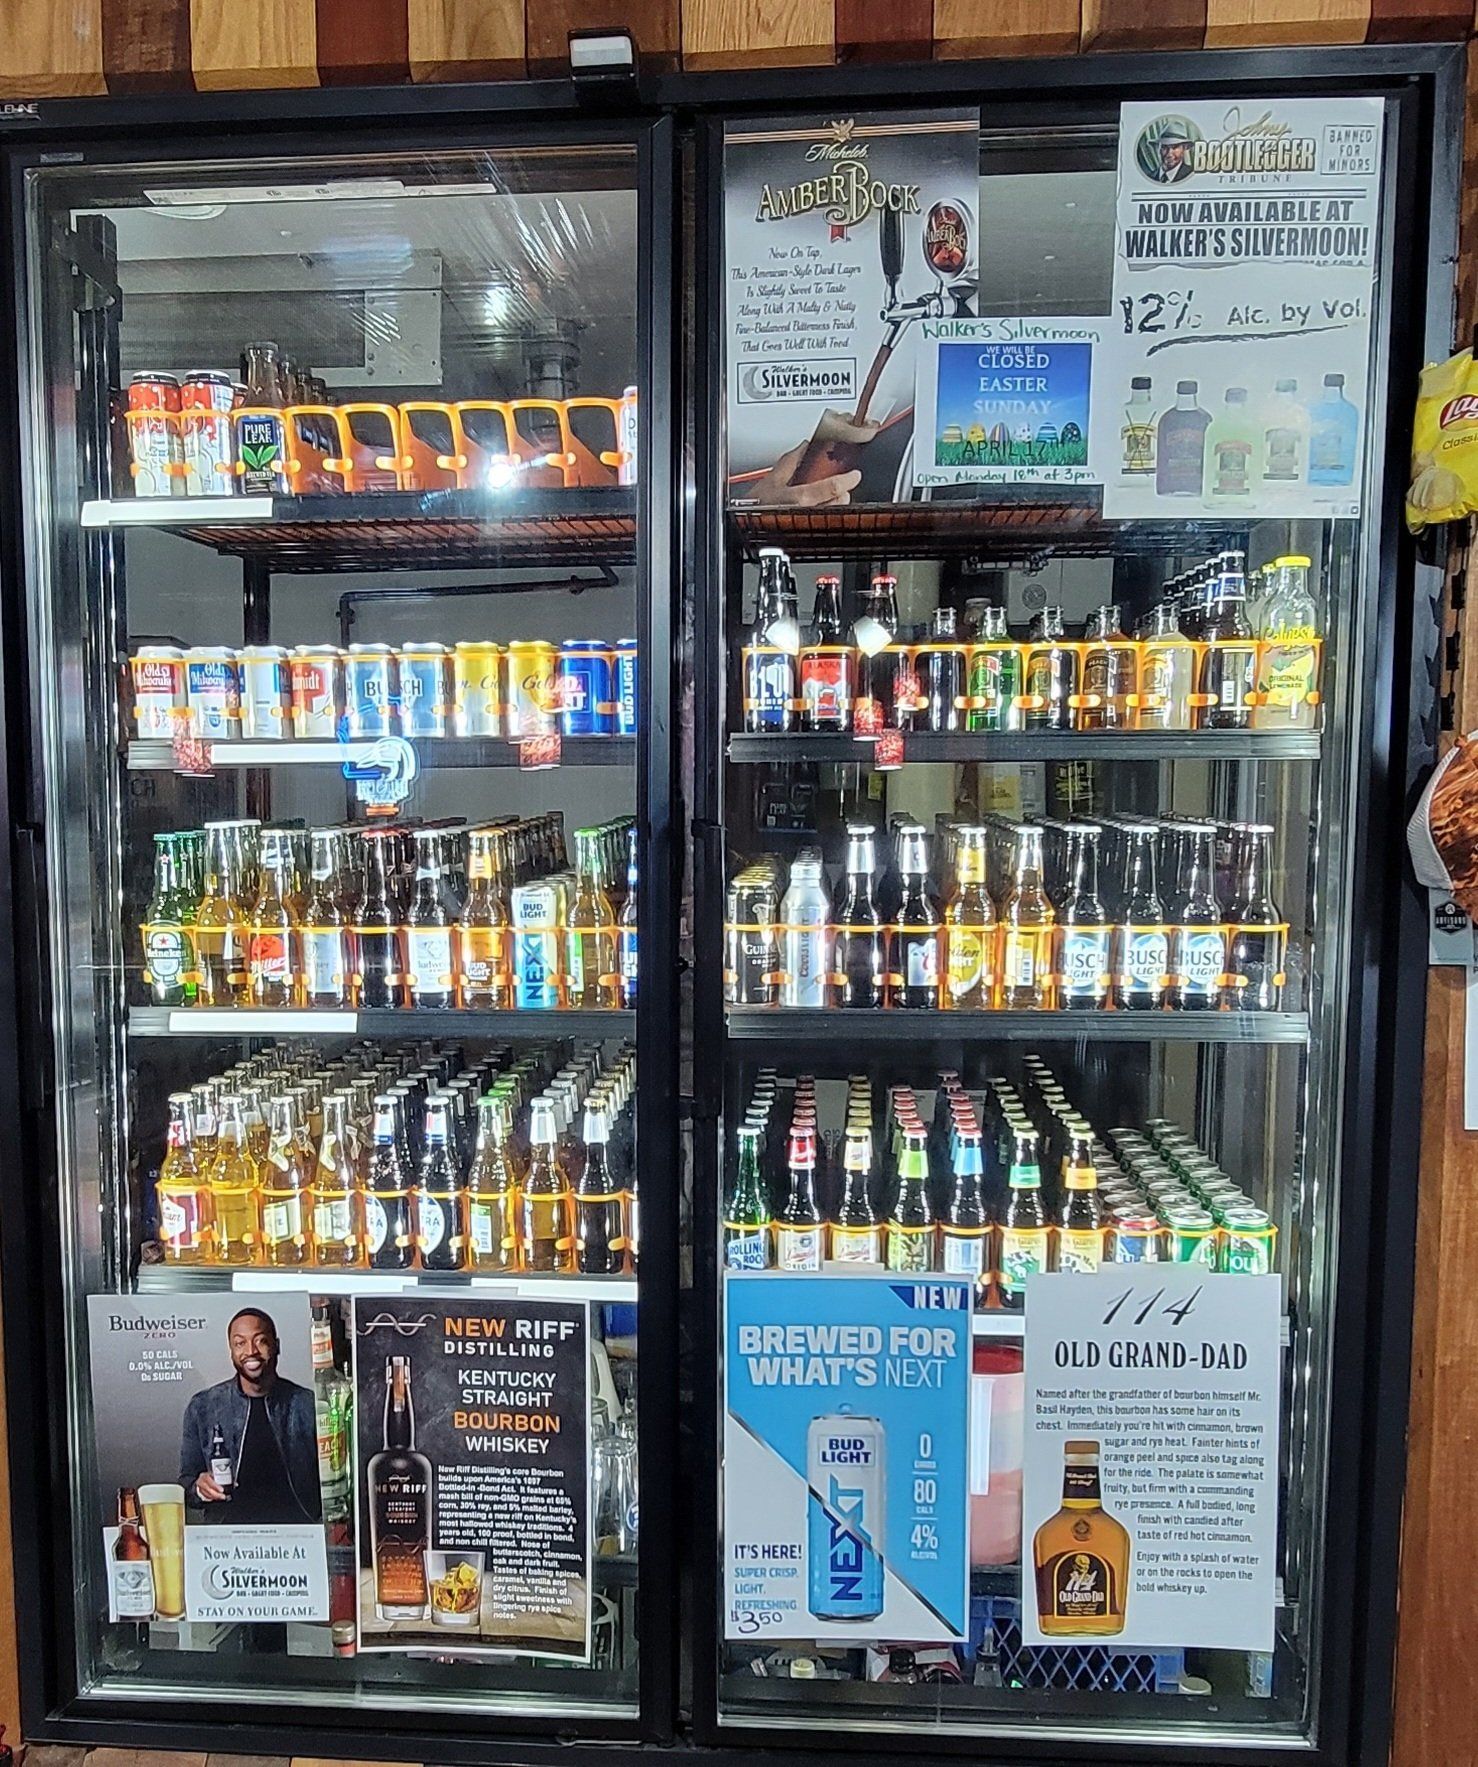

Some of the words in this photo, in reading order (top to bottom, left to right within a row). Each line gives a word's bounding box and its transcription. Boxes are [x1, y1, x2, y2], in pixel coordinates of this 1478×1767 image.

[1329, 130, 1372, 143] BANNED
[1194, 138, 1316, 173] BOOTLEGGER
[1339, 145, 1361, 156] FOR
[1328, 158, 1371, 172] MINORS
[1218, 175, 1293, 184] TRIBUNE
[1139, 203, 1194, 224] NOW
[1198, 201, 1323, 223] AVAILABLE
[1325, 201, 1353, 221] AT
[1126, 229, 1226, 259] WALKER'S
[1231, 227, 1369, 257] SILVERMOON!
[769, 247, 788, 259] Now
[790, 247, 803, 259] On
[732, 268, 747, 280] This
[814, 263, 835, 276] Dark
[837, 263, 861, 278] Lager
[746, 286, 754, 298] Is
[757, 284, 785, 299] Slightly
[788, 283, 812, 295] Sweet
[814, 283, 823, 294] To
[825, 282, 846, 293] Taste
[737, 305, 761, 318] Along
[763, 303, 783, 314] With
[786, 303, 795, 313] A
[797, 302, 820, 315] Malty
[823, 301, 831, 312] &
[1119, 290, 1202, 334] 12%
[1227, 305, 1270, 326] Alc.
[1281, 303, 1311, 326] by
[1322, 298, 1366, 320] Vol.
[922, 321, 992, 339] Walker's
[742, 340, 759, 352] That
[762, 340, 782, 351] Goes
[784, 338, 804, 350] Well
[806, 338, 827, 349] With
[986, 346, 1000, 354] WE
[1002, 346, 1023, 354] WILL
[1025, 346, 1036, 354] BE
[978, 354, 1050, 369] CLOSED
[762, 369, 851, 388] SILVERMOON
[979, 377, 1048, 392] EASTER
[973, 401, 1052, 415] SUNDAY
[245, 423, 272, 434] PURE
[963, 441, 1019, 457] APRIL
[956, 472, 1006, 483] Monday
[1044, 469, 1057, 480] at
[1064, 468, 1095, 483] 3pm
[522, 903, 543, 911] BUD
[520, 911, 547, 919] LIGHT
[913, 1286, 962, 1310] NEW
[1101, 1284, 1203, 1326] 114
[108, 1315, 207, 1332] Budweiser
[444, 1317, 506, 1337] NEW
[515, 1319, 574, 1341] RIFF
[738, 1326, 882, 1355] BREWED
[890, 1327, 956, 1357] FOR
[143, 1351, 154, 1359] 50
[157, 1350, 178, 1359] CALS
[444, 1341, 554, 1358] DISTILLING
[1054, 1340, 1101, 1368] OLD
[1108, 1342, 1248, 1370] GRAND-DAD
[129, 1361, 152, 1371] 0.0%
[748, 1357, 877, 1386] WHAT'S
[885, 1358, 946, 1388] NEXT
[152, 1372, 183, 1381] SUGAR
[458, 1369, 556, 1388] KENTUCKY
[462, 1389, 553, 1408] STRAIGHT
[1036, 1389, 1067, 1399] Named
[1069, 1389, 1090, 1399] after
[1093, 1389, 1107, 1399] the
[1109, 1389, 1161, 1401] grandfather
[1163, 1389, 1172, 1399] of
[1174, 1390, 1210, 1400] bourbon
[1212, 1391, 1246, 1401] himself
[1248, 1392, 1261, 1402] Mr.
[1036, 1404, 1058, 1415] Basil
[1059, 1405, 1095, 1417] Hayden,
[1096, 1405, 1113, 1415] this
[1115, 1405, 1151, 1416] bourbon
[1152, 1406, 1169, 1416] has
[1170, 1408, 1195, 1416] some
[1197, 1406, 1214, 1417] hair
[1216, 1409, 1227, 1417] on
[1229, 1407, 1240, 1417] its
[454, 1411, 561, 1433] BOURBON
[465, 1436, 550, 1454] WHISKEY
[828, 1439, 864, 1450] BUD
[920, 1434, 932, 1458] 0
[821, 1451, 872, 1464] LIGHT
[438, 1465, 455, 1473] New
[457, 1465, 470, 1473] Riff
[472, 1466, 511, 1475] Distilling's
[531, 1468, 564, 1477] Bourbon
[914, 1479, 936, 1504] 80
[823, 1472, 872, 1600] NEXT
[911, 1524, 938, 1549] 4%
[204, 1546, 231, 1560] Now
[233, 1545, 290, 1560] Available
[292, 1544, 306, 1559] At
[734, 1545, 758, 1560] IT'S
[762, 1545, 802, 1560] HERE!
[222, 1570, 308, 1589] SILVERMOON
[734, 1567, 767, 1578] SUPER
[769, 1567, 799, 1578] CRISP.
[734, 1583, 766, 1594] LIGHT.
[1137, 1582, 1155, 1592] bold
[1157, 1583, 1192, 1595] whiskey
[1194, 1584, 1207, 1595] up.
[198, 1606, 226, 1616] STAY
[228, 1606, 244, 1616] ON
[247, 1606, 279, 1616] YOUR
[734, 1600, 797, 1611] REFRESHING
